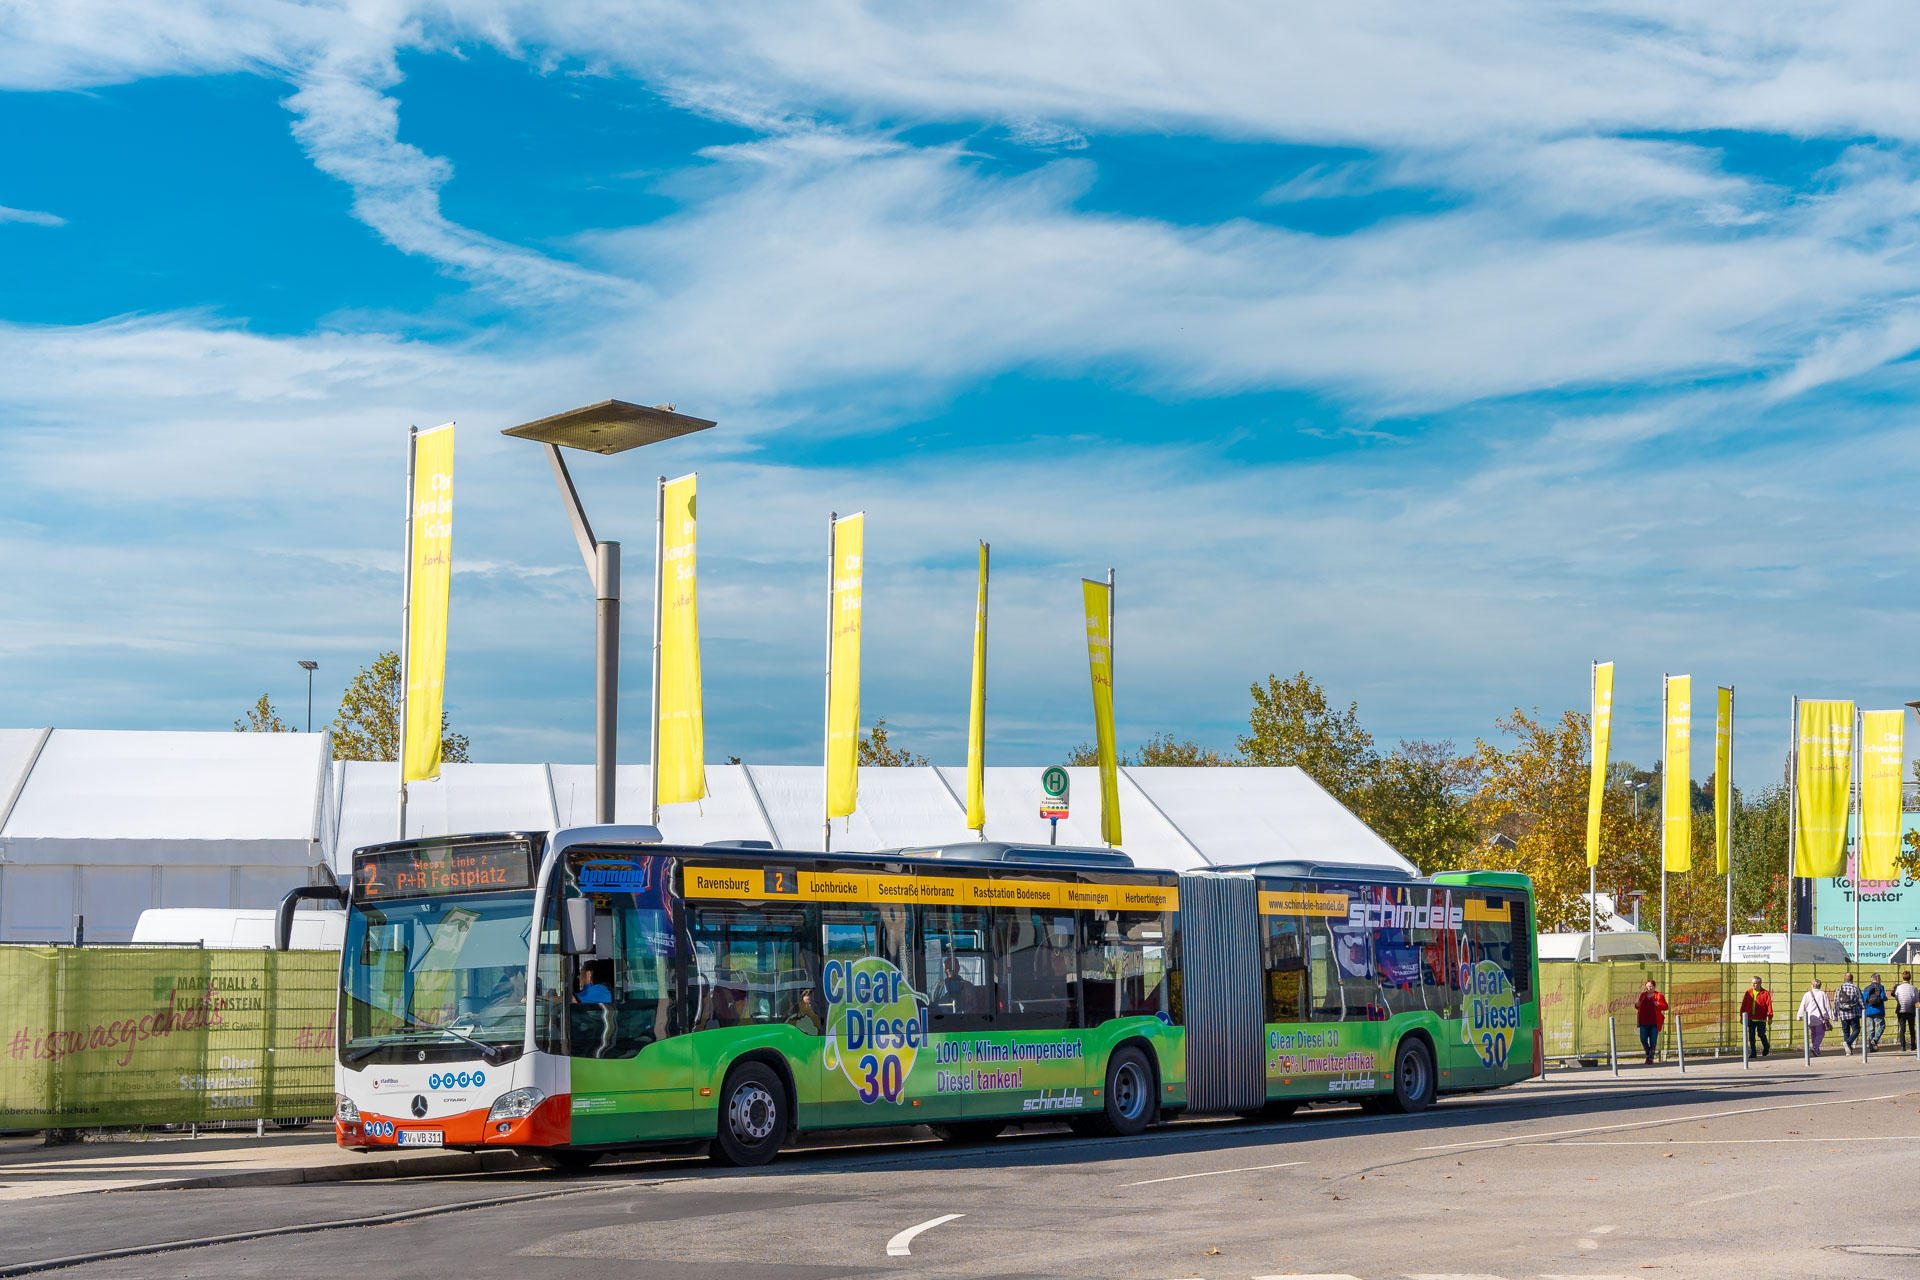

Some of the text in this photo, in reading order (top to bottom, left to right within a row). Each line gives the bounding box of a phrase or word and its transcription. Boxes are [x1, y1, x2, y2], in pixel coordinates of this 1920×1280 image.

[414, 856, 488, 871] Messe Linie 2
[365, 864, 378, 895] 2
[398, 867, 506, 890] P+R Festplatz
[697, 876, 750, 893] Ravensburg
[775, 872, 784, 892] 2
[810, 880, 858, 895] Lochbrücke
[878, 883, 955, 898] Seestraße Hörbranz
[973, 887, 1051, 901] Raststation Bodensee
[1068, 890, 1109, 904] Memmingen
[1125, 892, 1167, 906] Herbertingen
[1844, 891, 1903, 902] Theater
[1269, 899, 1345, 912] www.schindele-handel.de
[1348, 886, 1463, 930] schindele
[177, 976, 259, 991] MARSCHALL &
[824, 960, 902, 1004] Clear
[1460, 963, 1504, 995] Clear
[1473, 997, 1521, 1030] Diesel
[846, 1007, 929, 1050] Diesel
[1270, 1029, 1339, 1050] Clear Diesel 30
[936, 1038, 1082, 1065] 100 % Klima kompensiert
[1481, 1032, 1507, 1069] 30
[220, 1055, 255, 1071] Ober
[1301, 1051, 1374, 1073] Umweltzertifikat
[858, 1054, 903, 1104] 30
[936, 1067, 1023, 1092] Diesel tanken!
[1328, 1071, 1375, 1091] schindele
[211, 1090, 254, 1108] Schau
[1023, 1087, 1083, 1111] schindele
[403, 1131, 442, 1144] RV VB 311
